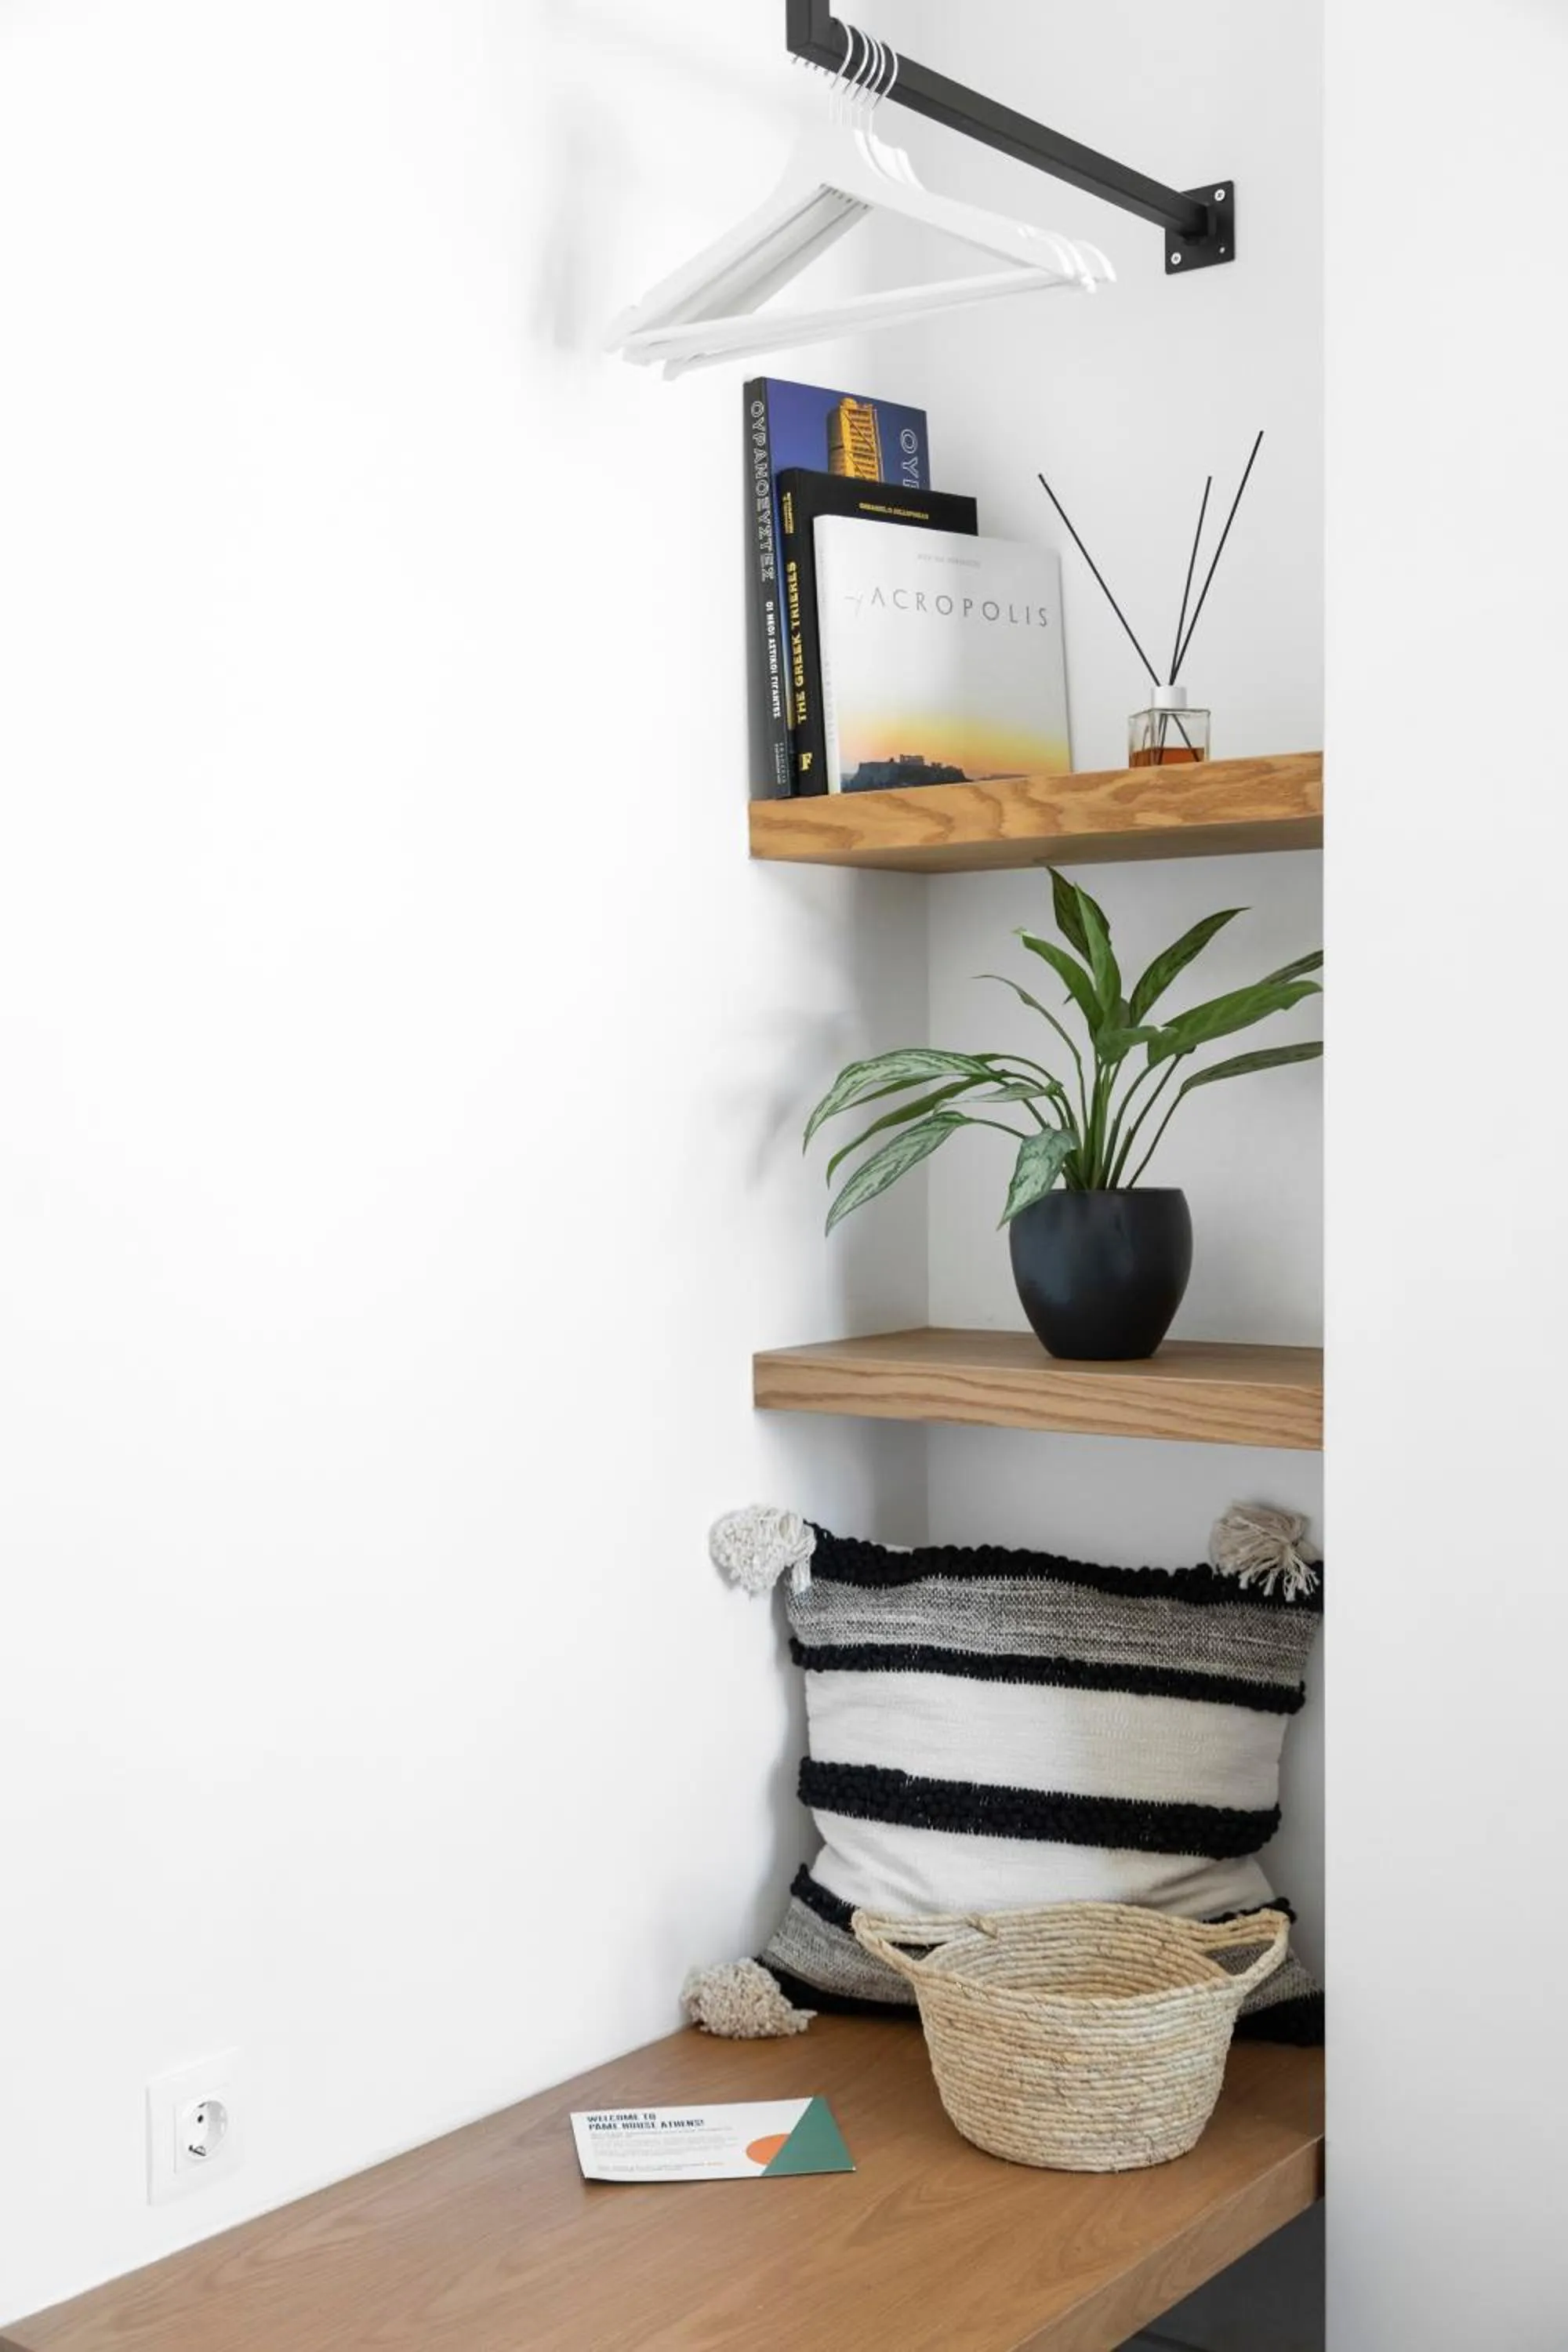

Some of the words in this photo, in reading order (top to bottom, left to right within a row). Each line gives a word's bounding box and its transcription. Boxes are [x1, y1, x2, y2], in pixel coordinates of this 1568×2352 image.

[786, 561, 800, 630] TRIERES
[871, 586, 1047, 627] ACROPOLIS
[792, 633, 804, 687] GREEK
[796, 691, 807, 724] THE
[586, 2113, 638, 2123] WELCOME
[644, 2112, 656, 2121] TO
